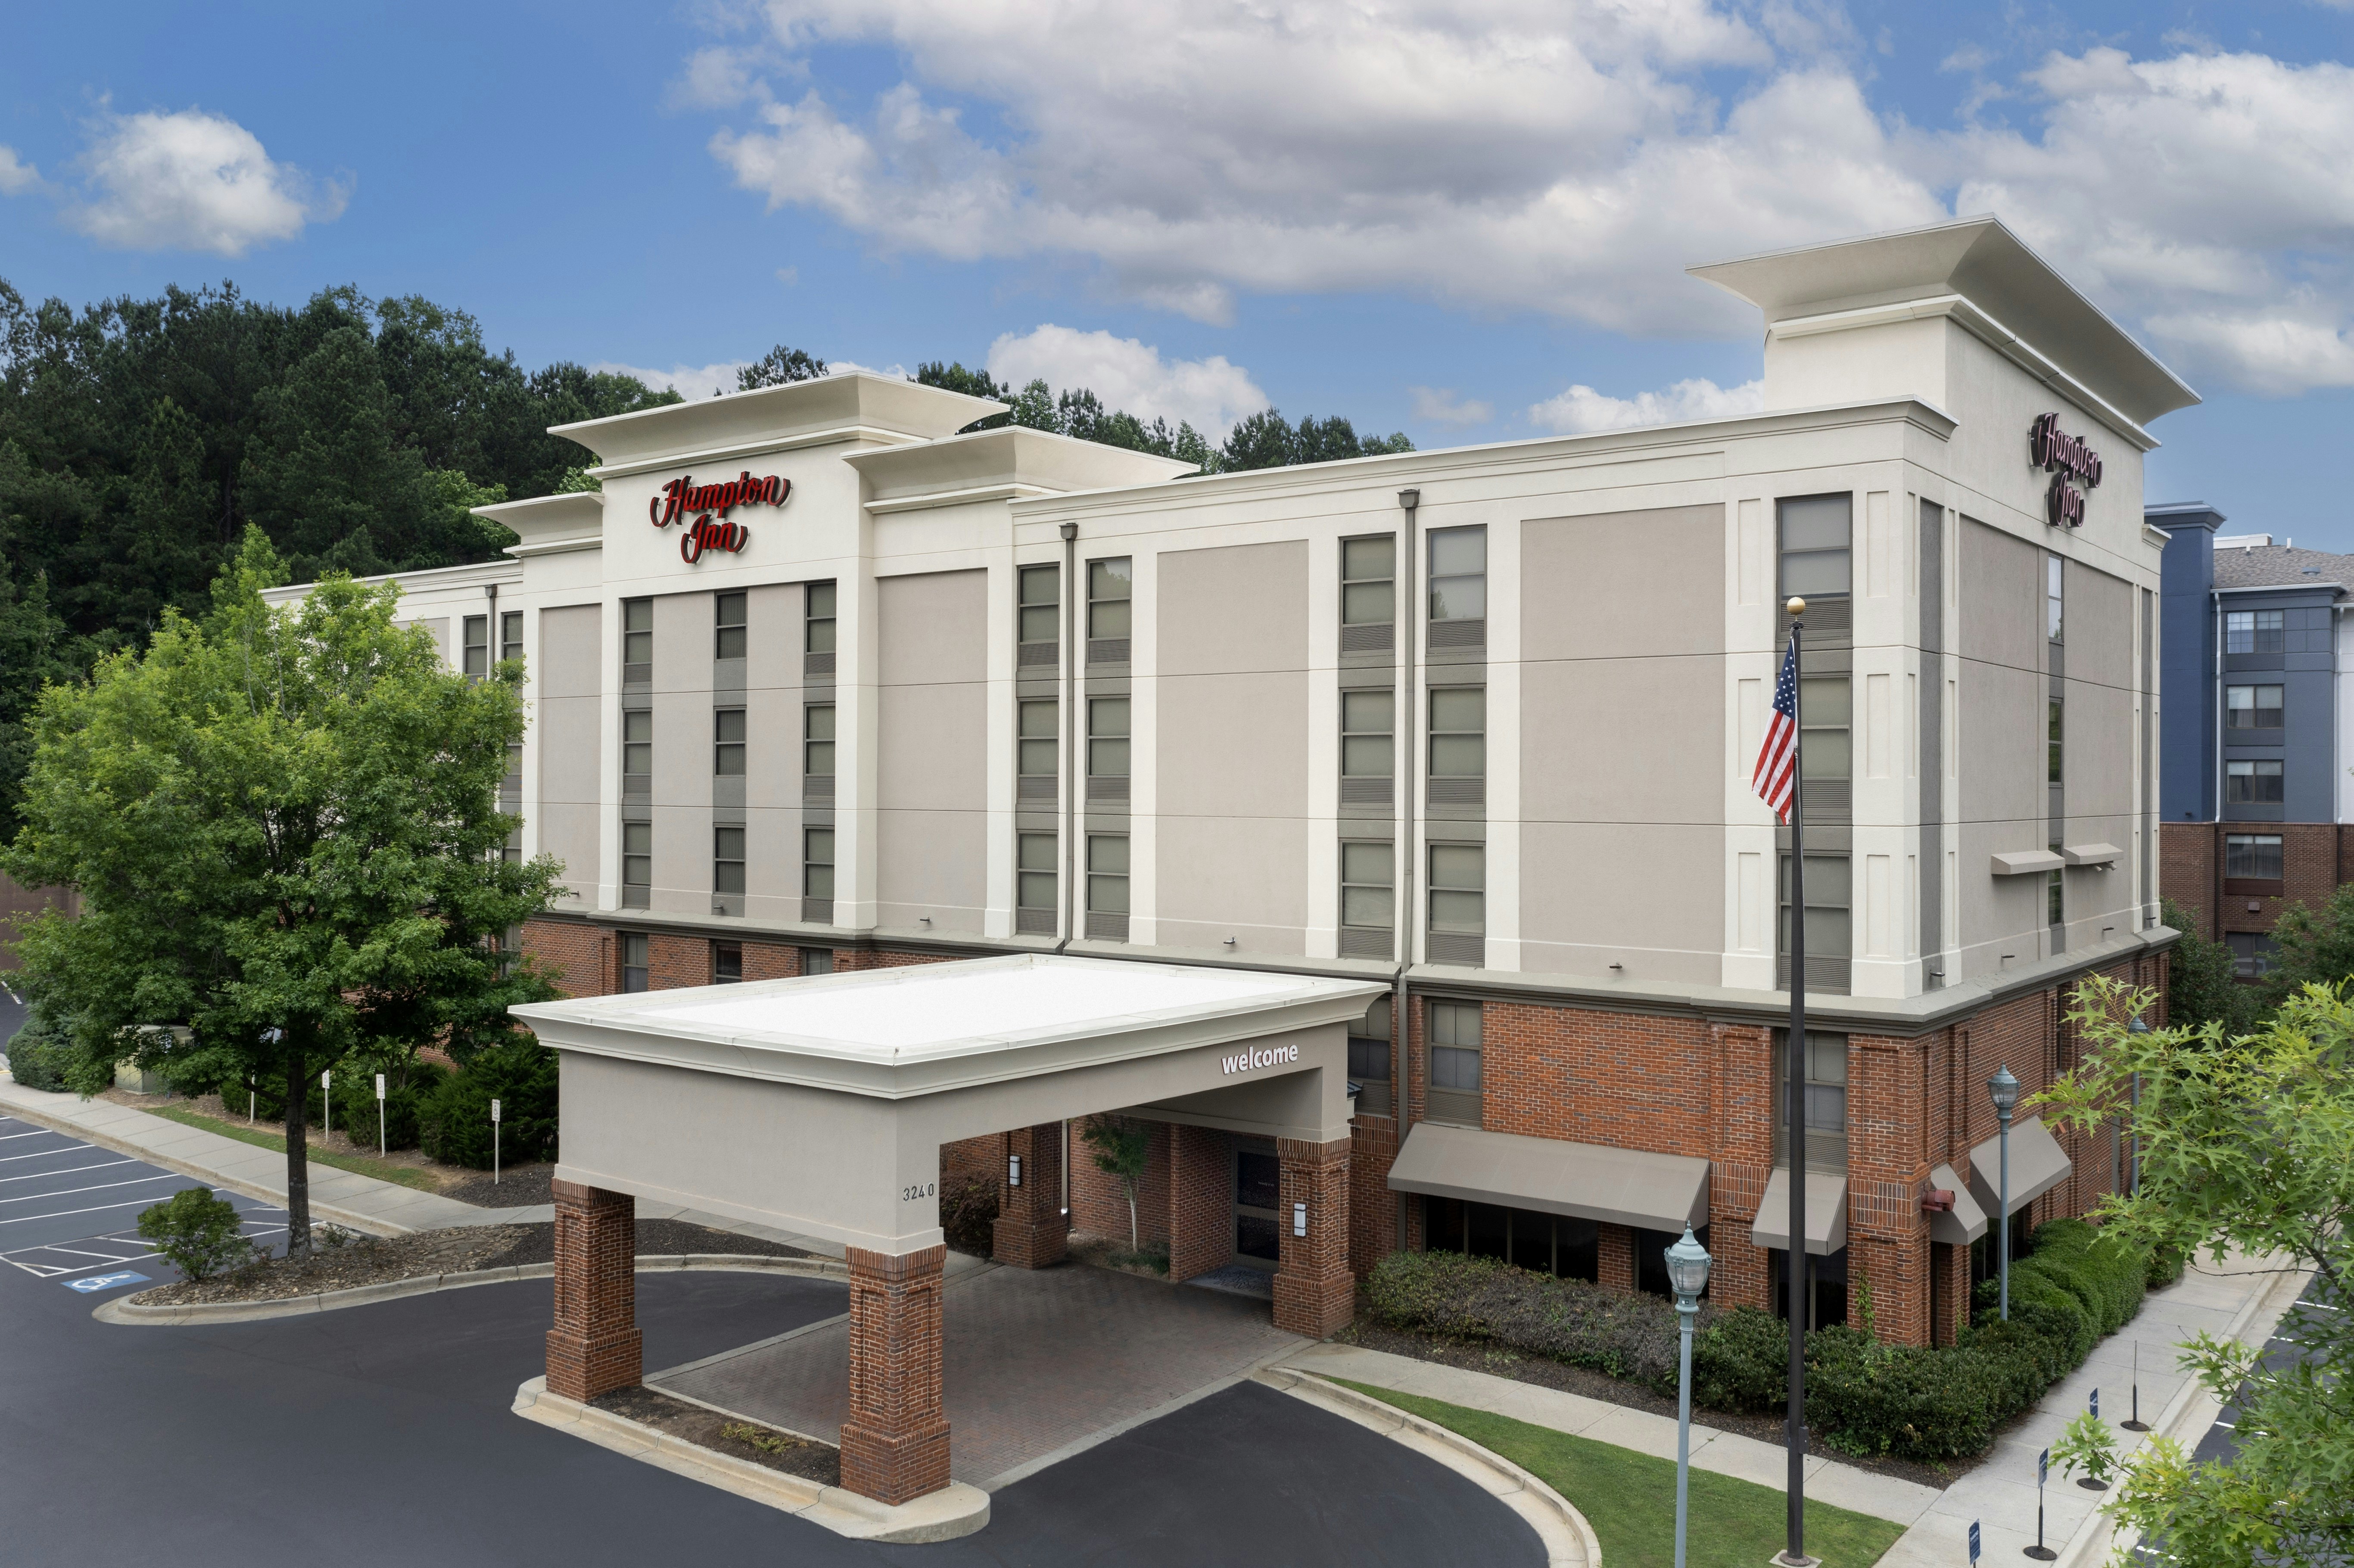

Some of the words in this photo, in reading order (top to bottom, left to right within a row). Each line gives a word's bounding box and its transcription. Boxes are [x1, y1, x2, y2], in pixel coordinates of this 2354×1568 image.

[2031, 412, 2102, 488] Hampton
[650, 471, 791, 527] Hampton
[2048, 471, 2085, 527] Inn
[681, 514, 748, 564] Inn
[1221, 1045, 1298, 1074] welcome
[903, 1183, 934, 1201] 3240
